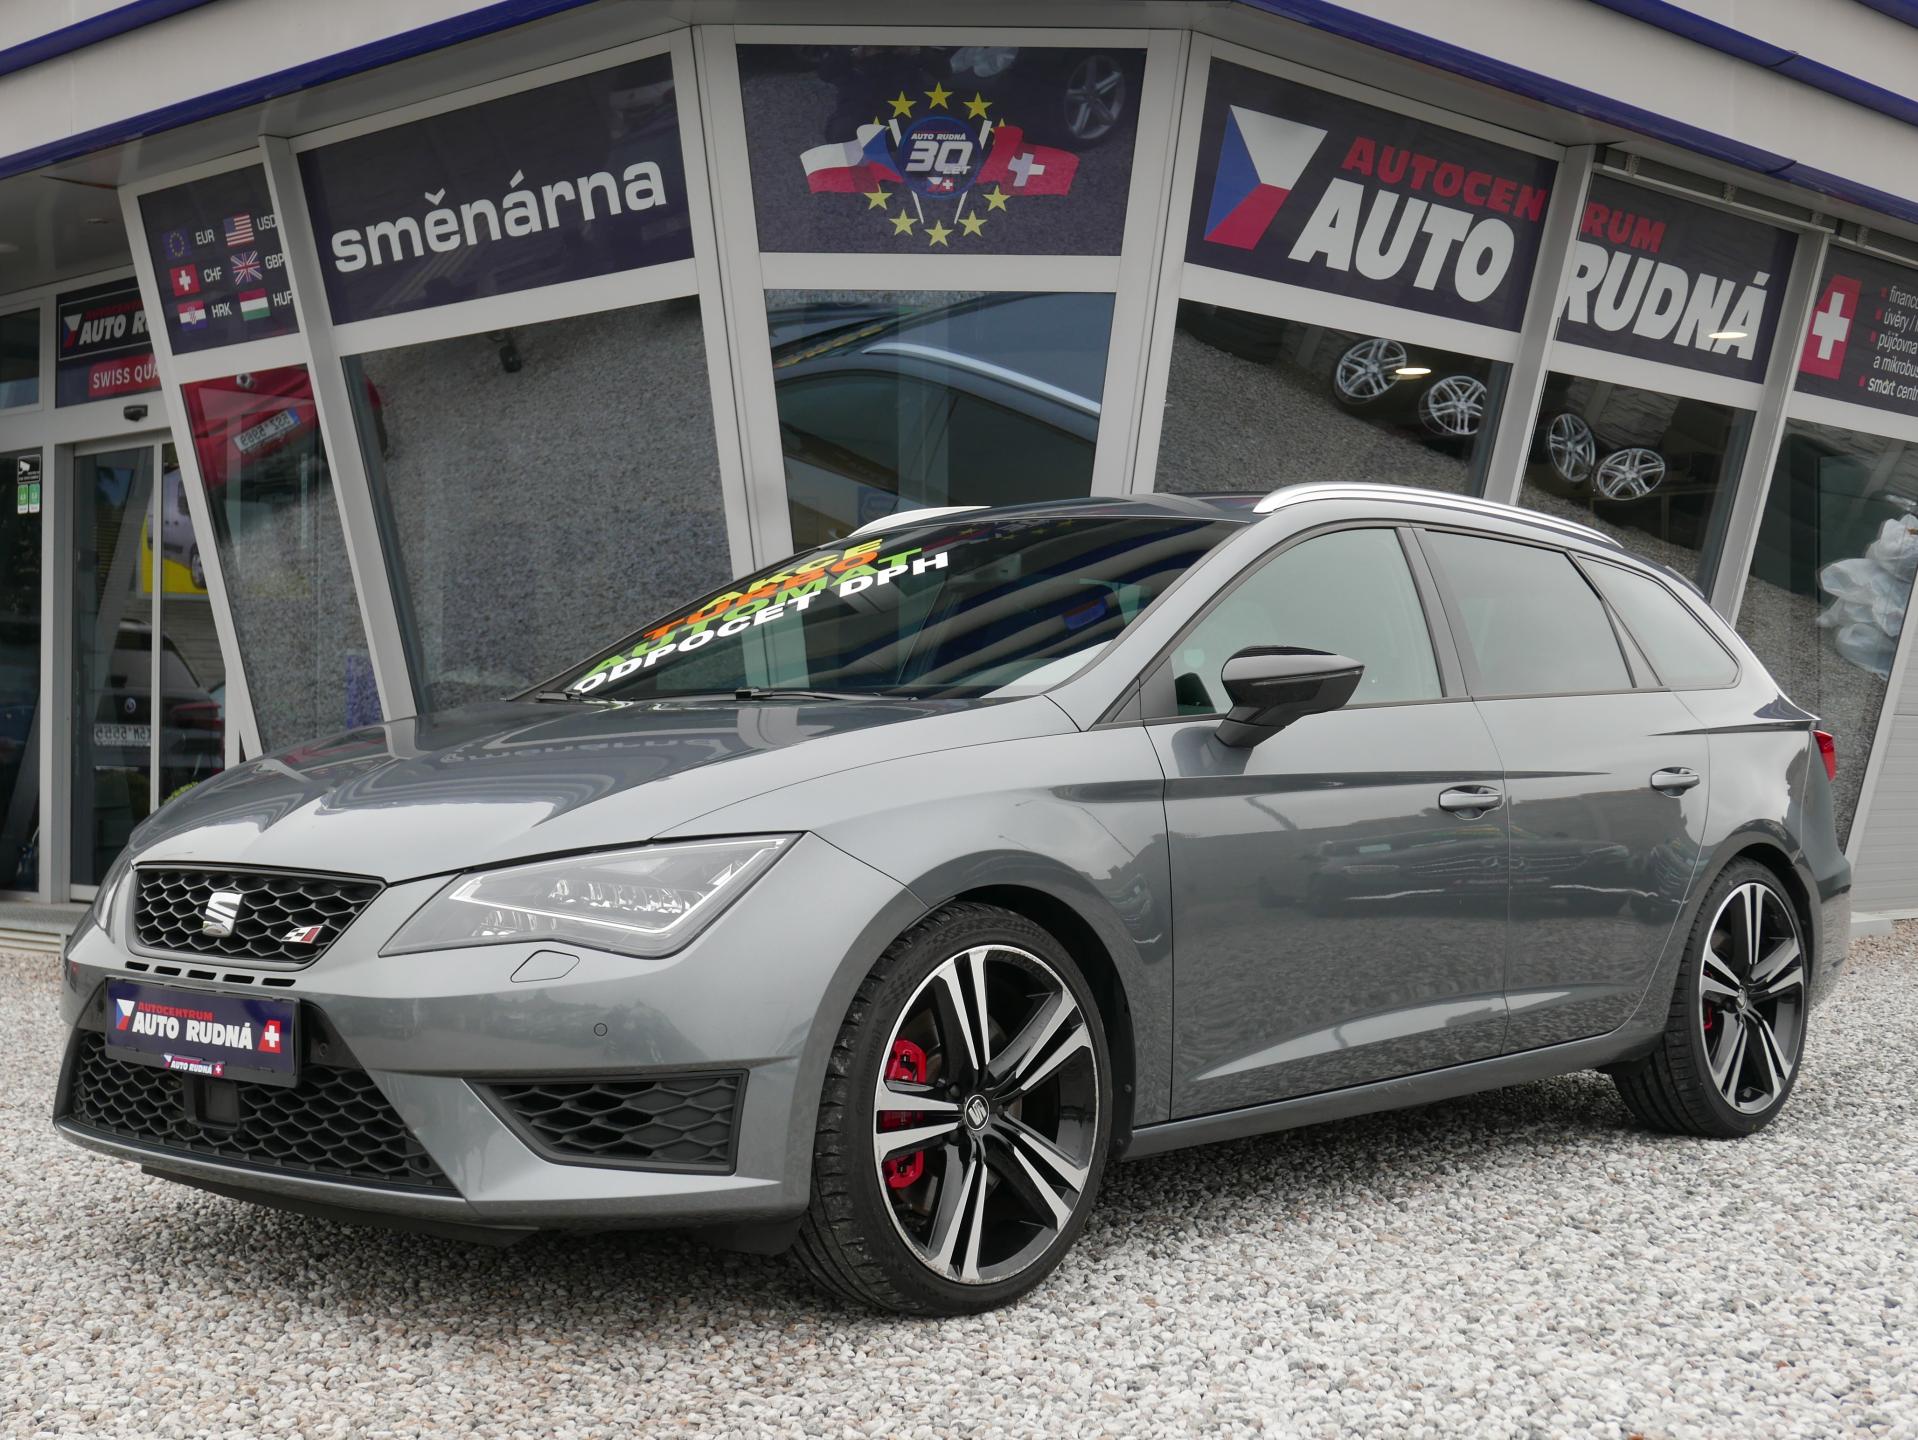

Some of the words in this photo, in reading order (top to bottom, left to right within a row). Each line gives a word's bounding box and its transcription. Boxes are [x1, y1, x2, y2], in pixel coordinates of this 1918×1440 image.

[905, 140, 973, 172] 30
[331, 161, 667, 273] směnárna
[195, 229, 215, 245] EUR
[265, 253, 284, 269] GBP
[1288, 177, 1514, 302] AUTO
[1557, 240, 1770, 361] RUDNÁ
[203, 267, 222, 283] CHF
[211, 302, 232, 318] HRK
[273, 290, 293, 306] HUF
[78, 314, 126, 345] AUTO
[132, 309, 150, 335] R
[1883, 307, 1909, 333] úvěry
[1877, 330, 1918, 355] půjčovna
[1873, 355, 1881, 369] a
[93, 367, 130, 389] SWISS
[698, 538, 883, 613] AKCE
[643, 551, 878, 641] TURBO
[573, 590, 821, 694] ODPOCET
[839, 551, 948, 598] DPH
[582, 548, 922, 678] AUTOMAT
[137, 1001, 214, 1021] AUTOCENTRUM
[132, 1012, 180, 1039] AUTO
[186, 1022, 253, 1050] RUDNÁ
[171, 1060, 188, 1071] AUTO
